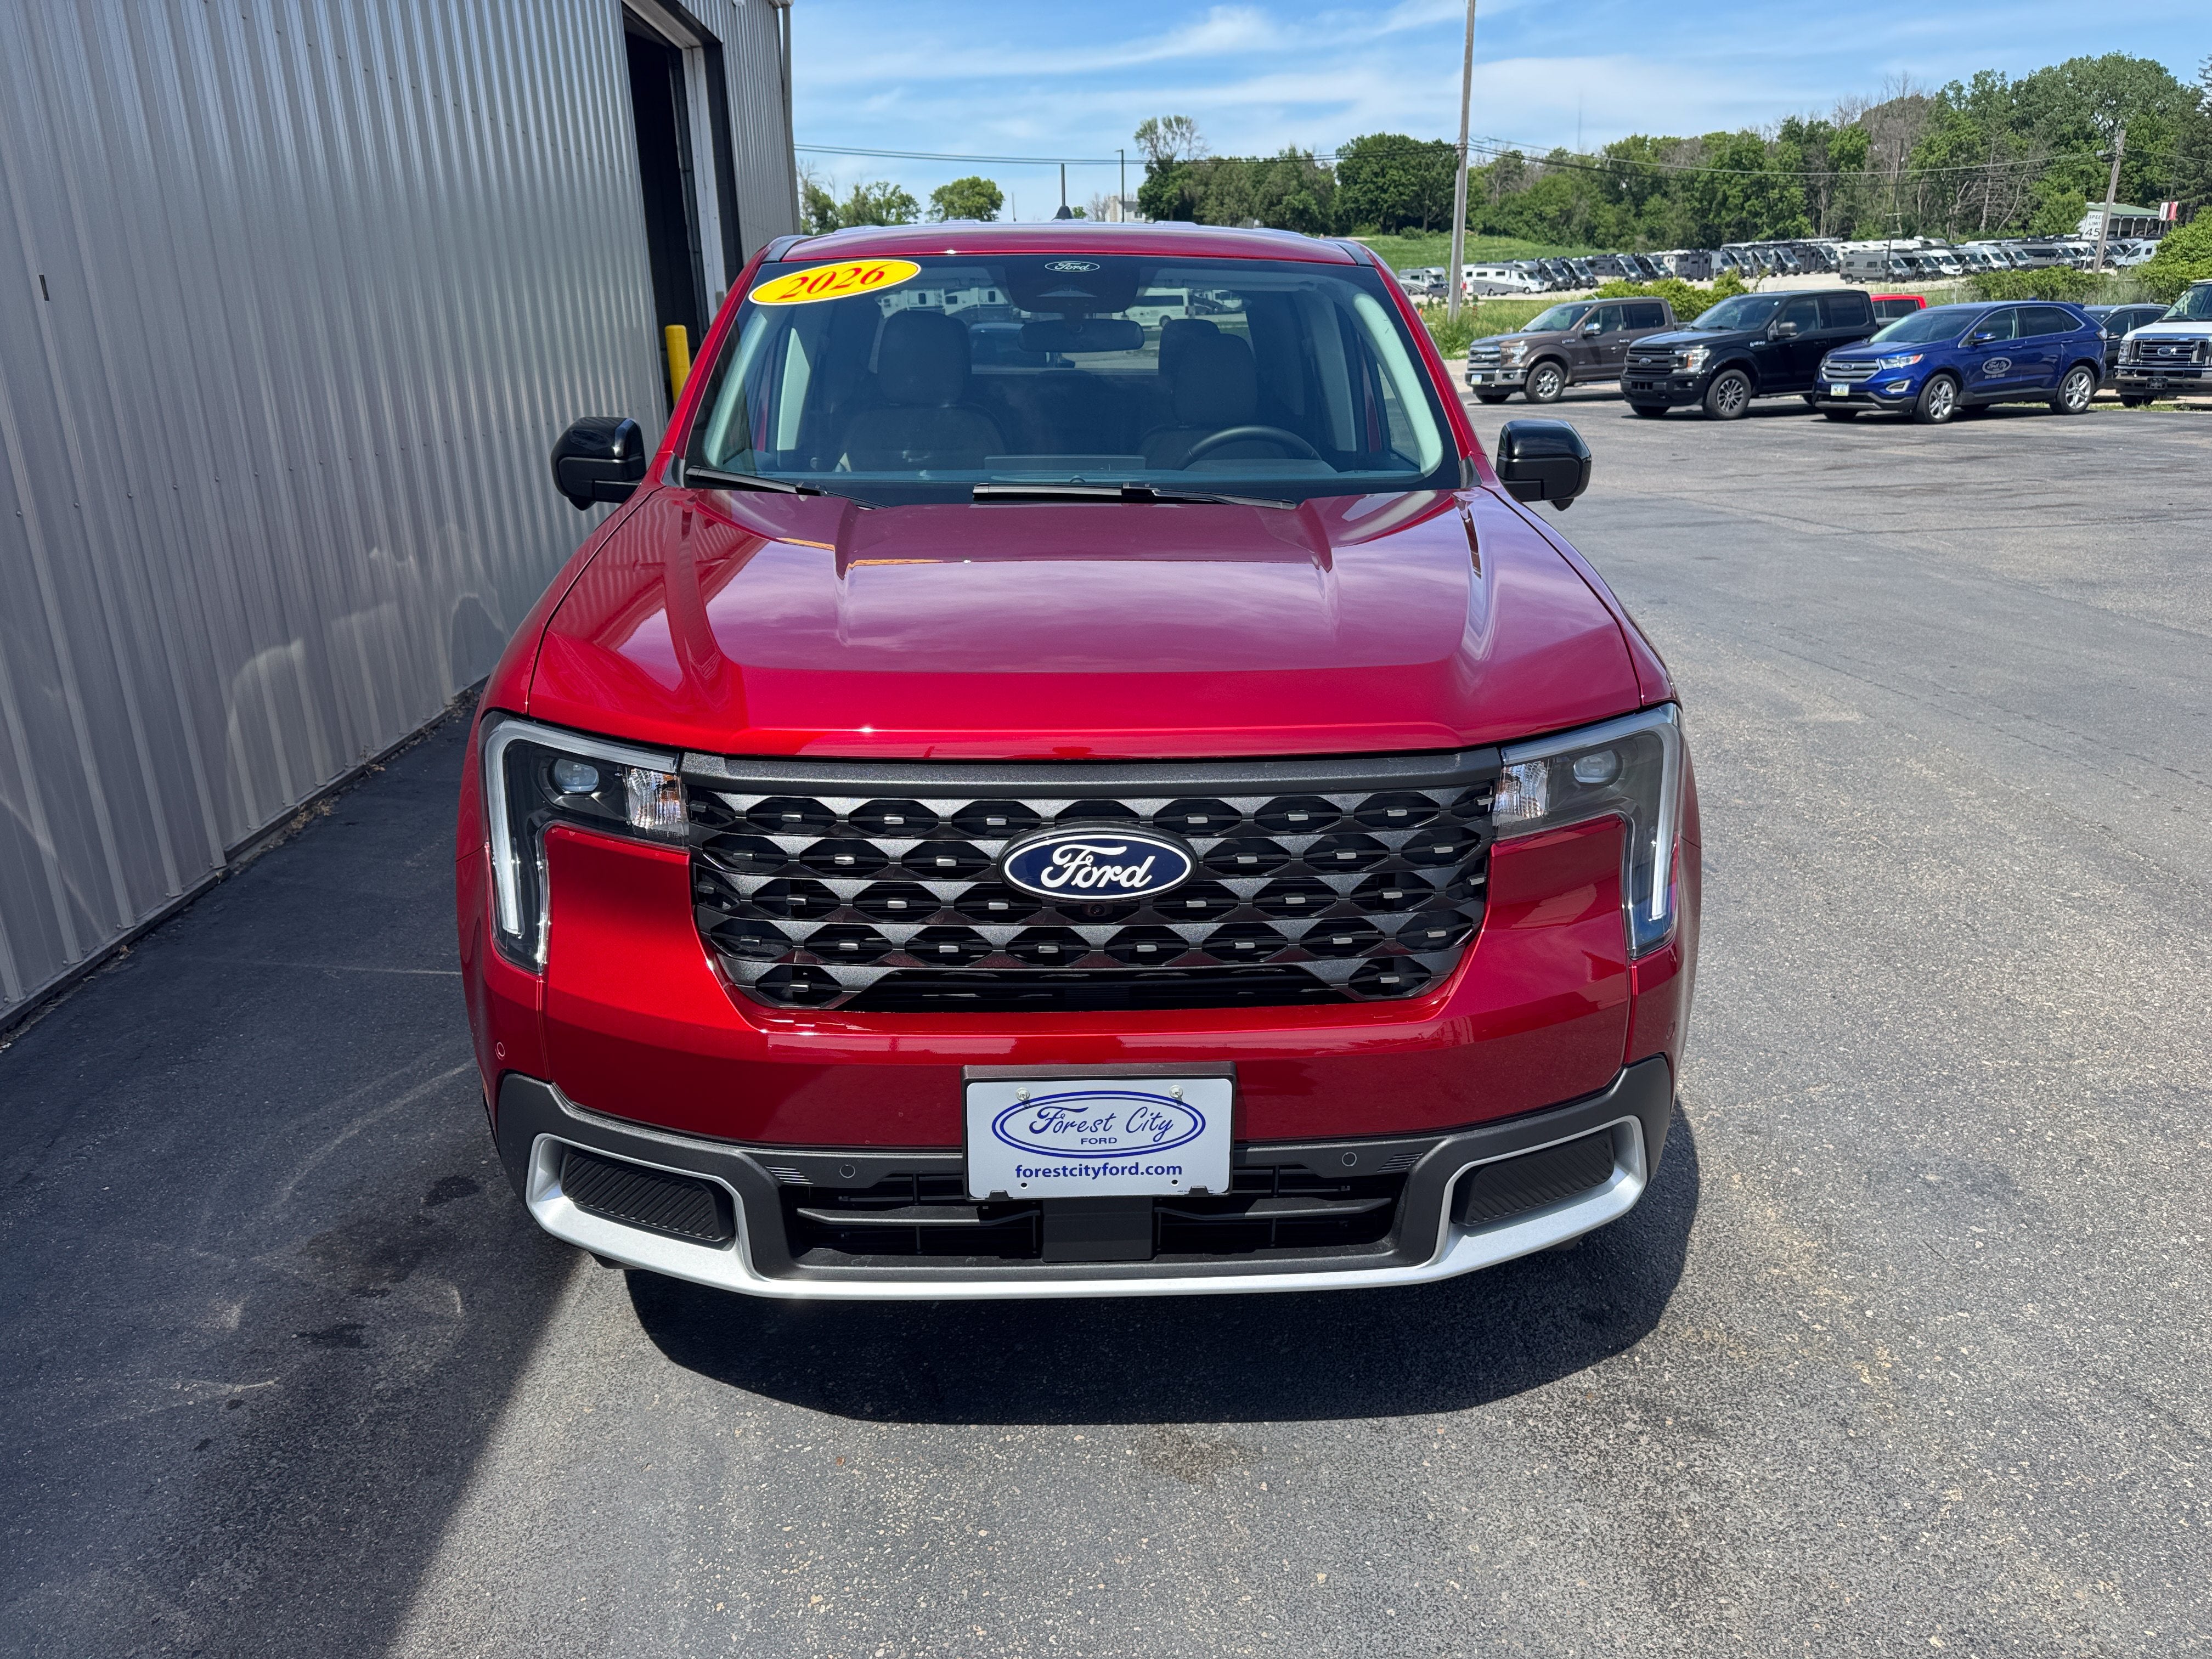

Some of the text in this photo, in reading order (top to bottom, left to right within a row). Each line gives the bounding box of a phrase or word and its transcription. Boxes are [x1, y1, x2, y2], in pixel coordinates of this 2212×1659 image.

[2085, 228, 2102, 237] 45
[1054, 262, 1090, 270] Ford
[775, 263, 894, 300] 2026
[1041, 844, 1155, 888] Ford
[1029, 1106, 1174, 1142] Forest City
[1015, 1161, 1183, 1180] forestcityford.com
